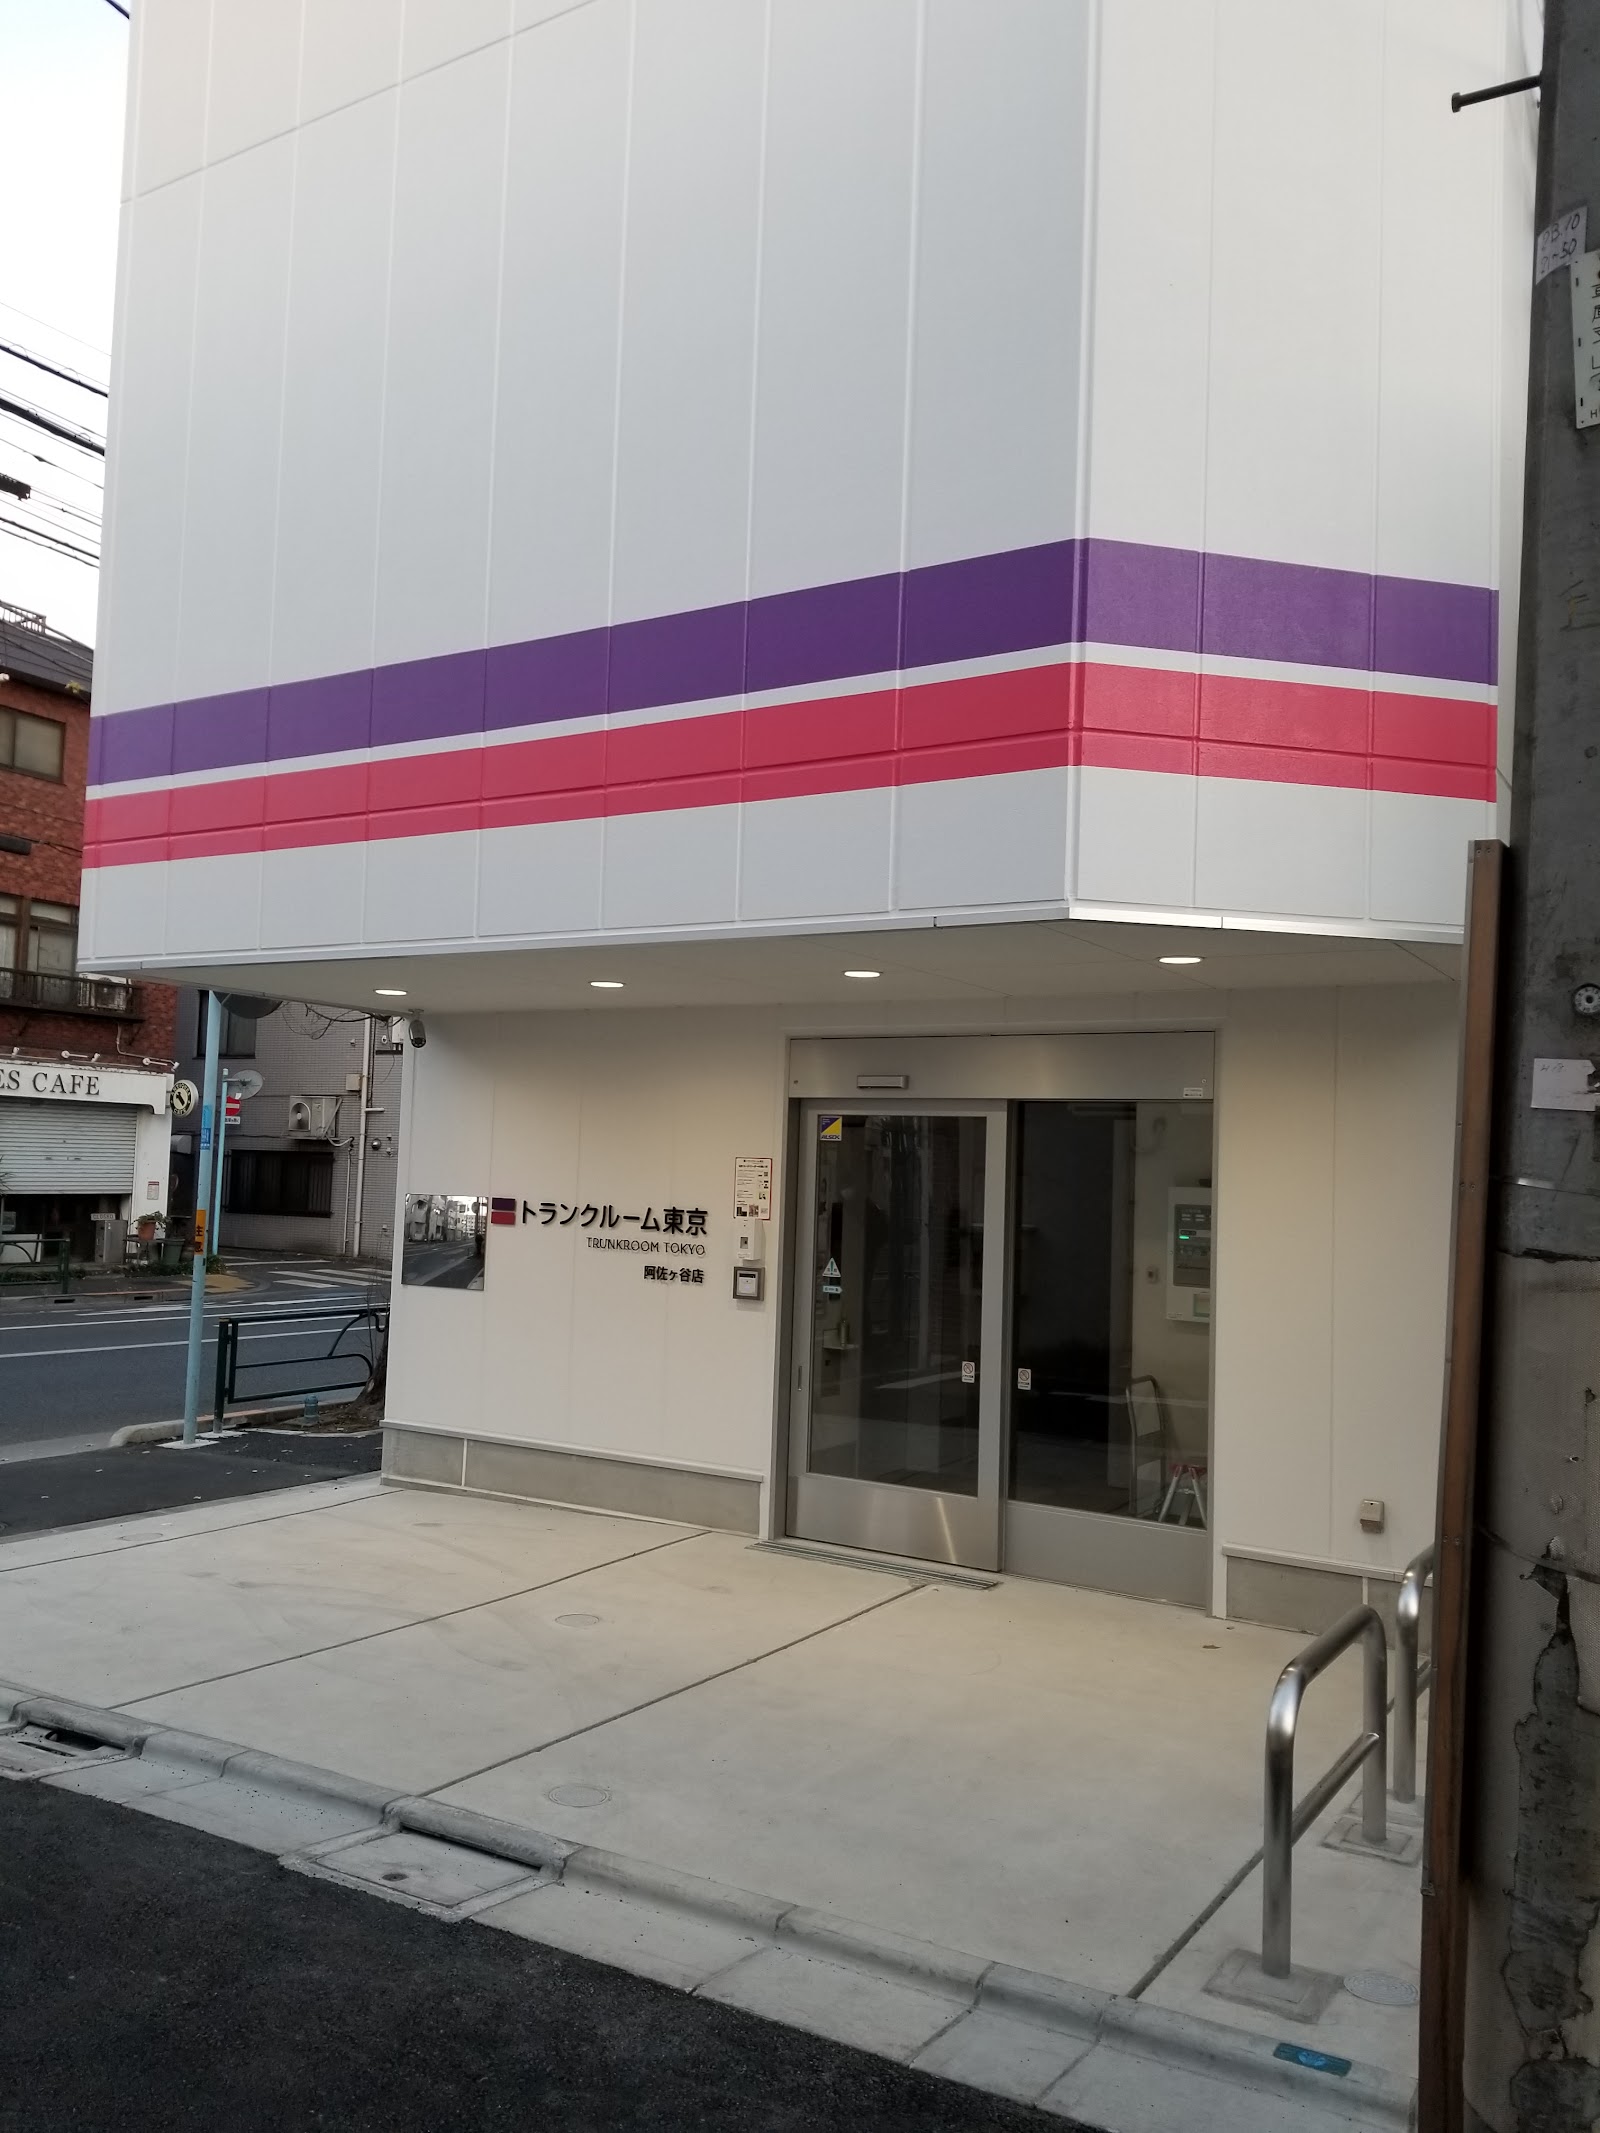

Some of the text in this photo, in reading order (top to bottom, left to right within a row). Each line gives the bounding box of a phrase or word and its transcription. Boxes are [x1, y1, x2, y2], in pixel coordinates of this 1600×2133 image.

[32, 1072, 100, 1096] CAFE
[522, 1200, 708, 1236] トランクルーム東京
[586, 1236, 706, 1256] TRUNKROOM TOKYO
[643, 1265, 705, 1284] 阿佐ヶ谷店
